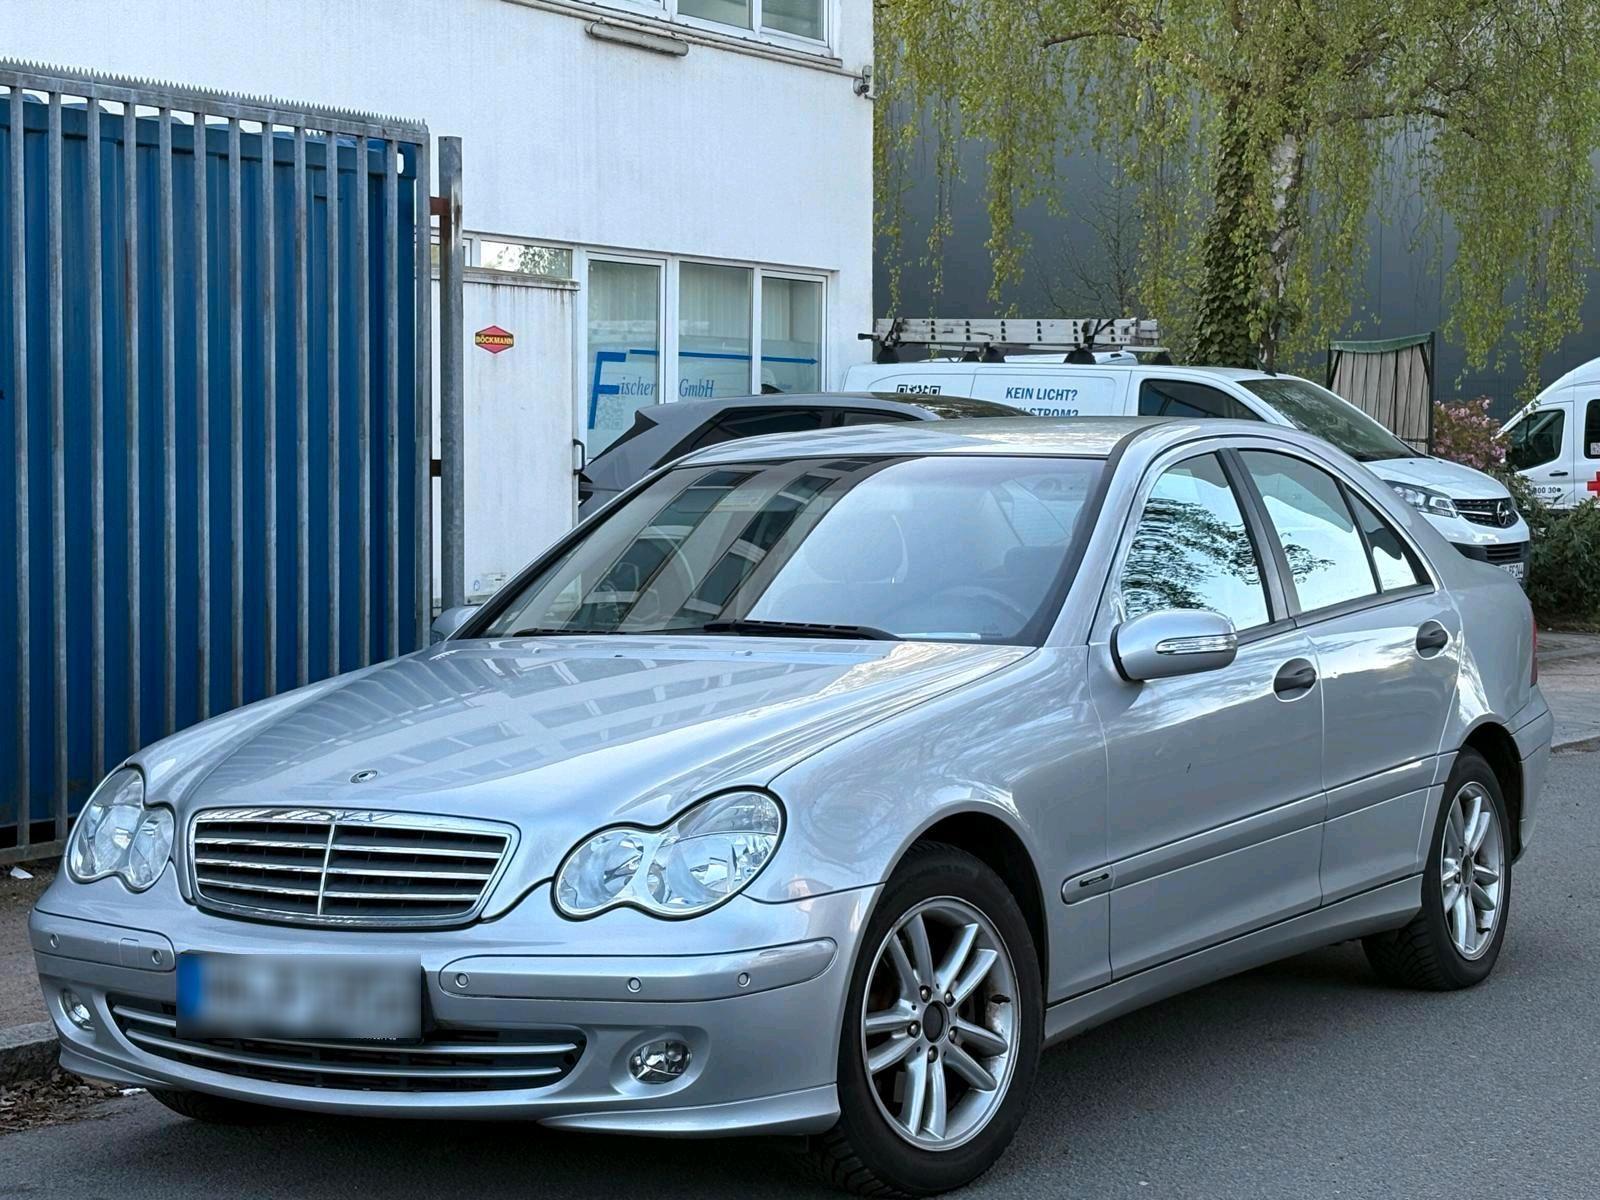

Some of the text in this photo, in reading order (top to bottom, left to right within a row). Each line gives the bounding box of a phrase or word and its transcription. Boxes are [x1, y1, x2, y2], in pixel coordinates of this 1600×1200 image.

[475, 334, 513, 345] BÖCKMANN
[679, 378, 716, 399] GmbH
[1005, 386, 1079, 402] KEIN LICHT?
